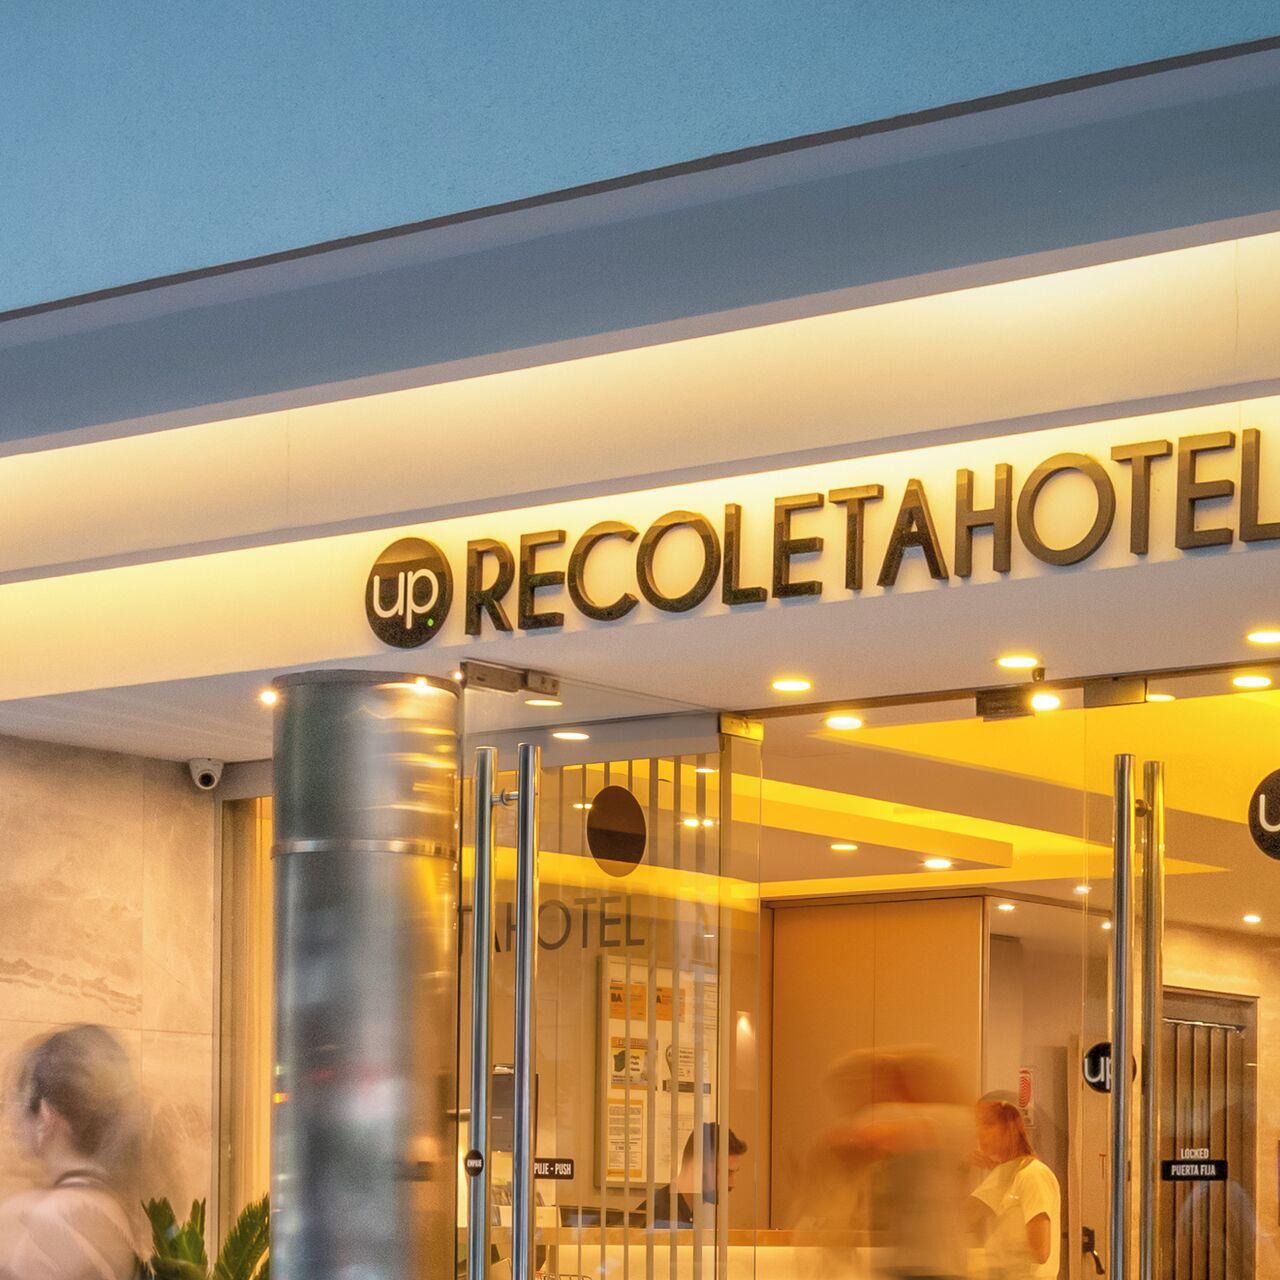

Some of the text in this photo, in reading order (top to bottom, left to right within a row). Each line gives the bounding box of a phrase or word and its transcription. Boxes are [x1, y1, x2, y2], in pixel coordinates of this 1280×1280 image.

[1180, 1148, 1209, 1160] LOCKED
[534, 1162, 549, 1174] PUJE
[555, 1163, 571, 1175] PUSH
[1171, 1164, 1199, 1176] PUERTA
